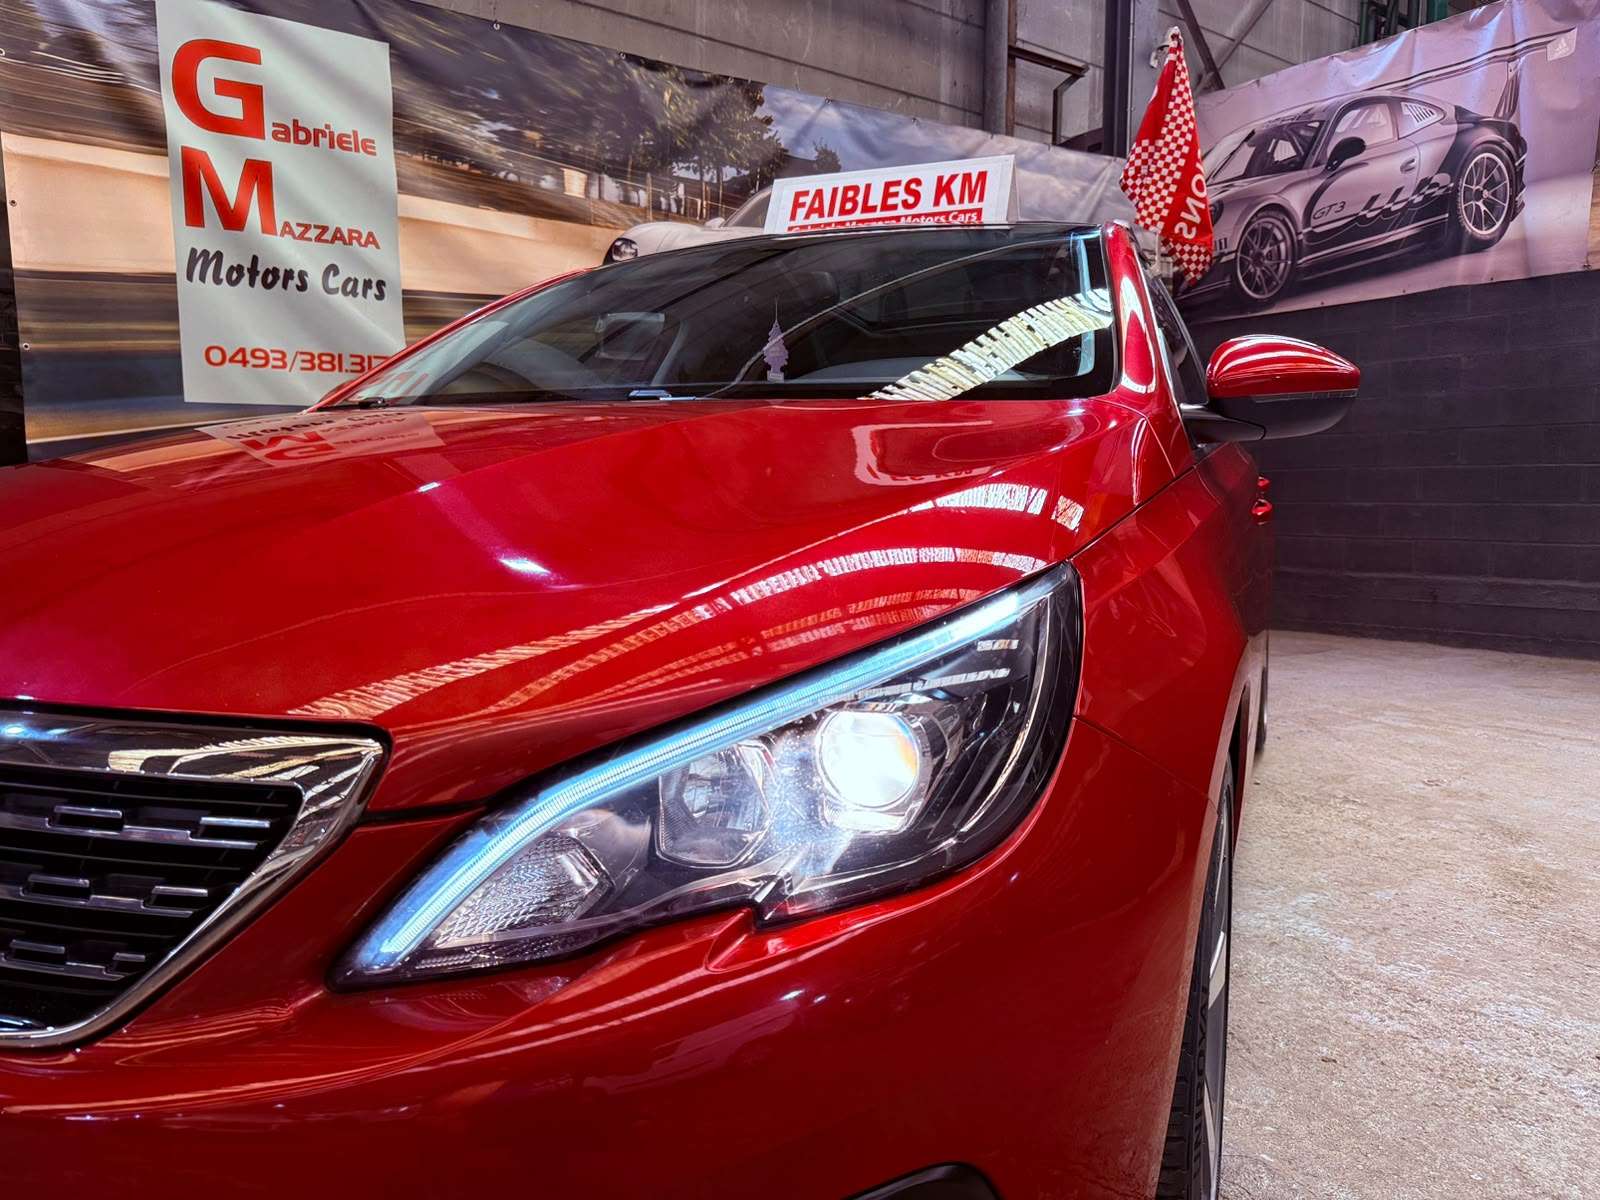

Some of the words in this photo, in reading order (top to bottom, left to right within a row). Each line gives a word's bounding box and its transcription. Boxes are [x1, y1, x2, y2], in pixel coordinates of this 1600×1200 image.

[789, 177, 923, 222] FAIBLES
[933, 170, 988, 207] KM
[1313, 201, 1346, 220] GT3
[900, 214, 947, 223] Motors
[949, 211, 977, 223] Cars
[186, 247, 309, 292] Motors
[322, 263, 387, 301] Cars
